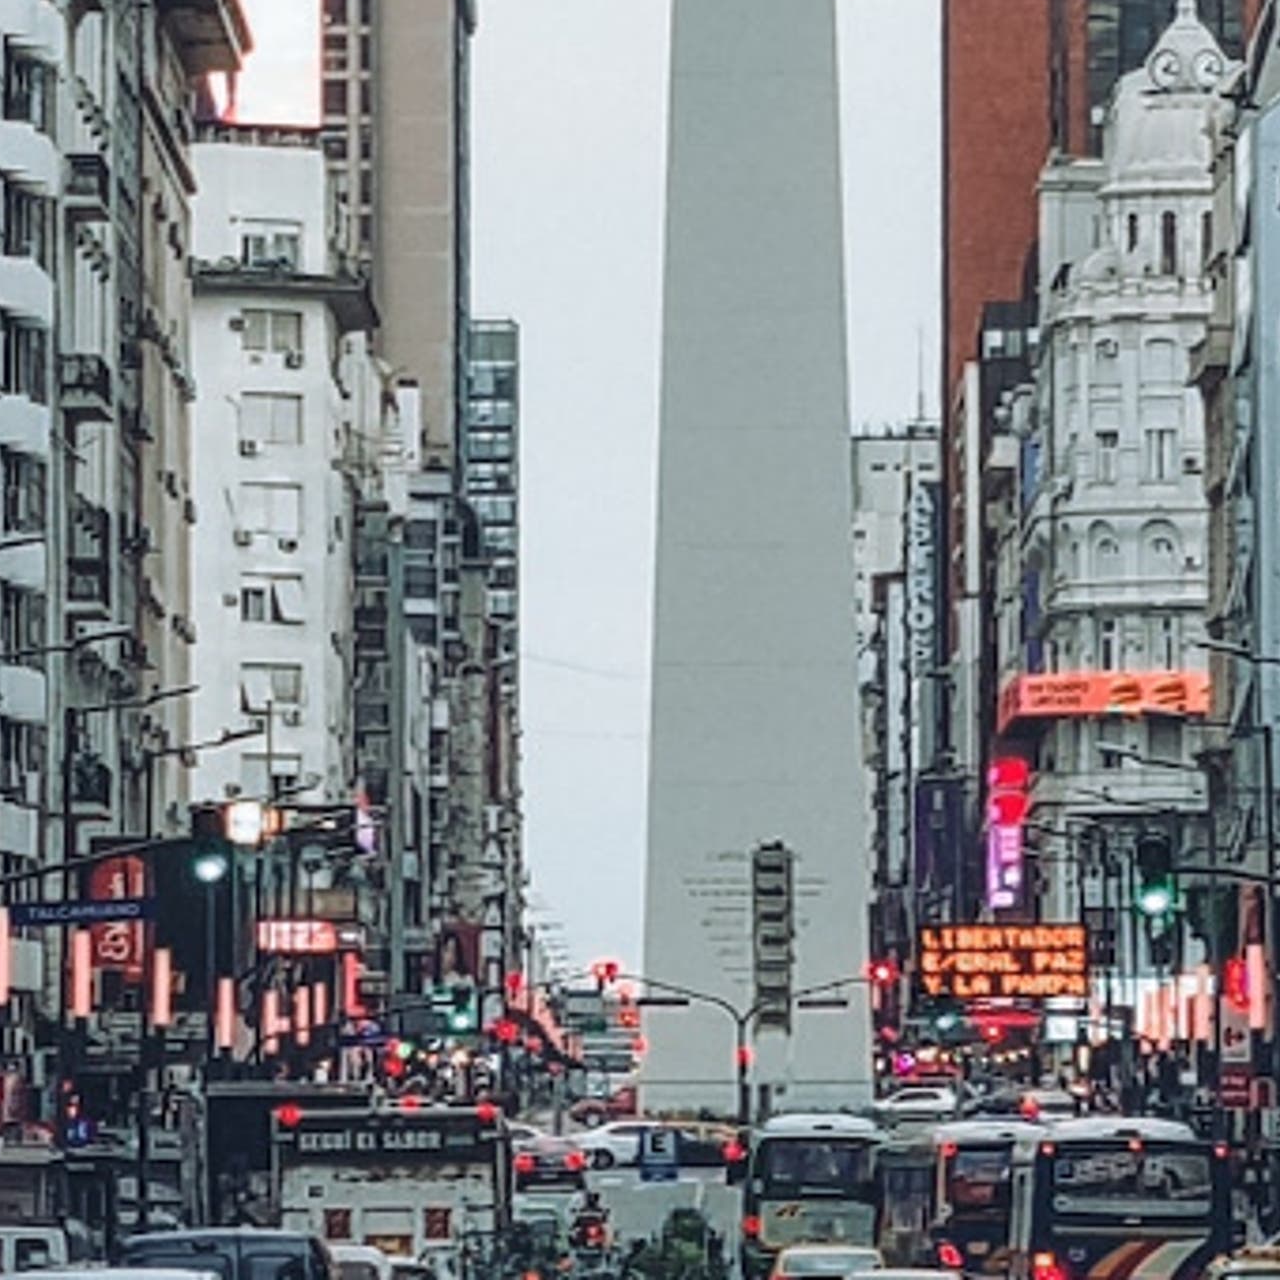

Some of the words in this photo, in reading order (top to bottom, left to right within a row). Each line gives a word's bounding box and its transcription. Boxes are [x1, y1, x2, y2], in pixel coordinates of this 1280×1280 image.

[922, 926, 1085, 950] LIBERTADOR
[1032, 951, 1085, 973] PAZ
[923, 974, 941, 995] Y
[953, 974, 991, 996] LA
[1001, 974, 1085, 996] PAMPA
